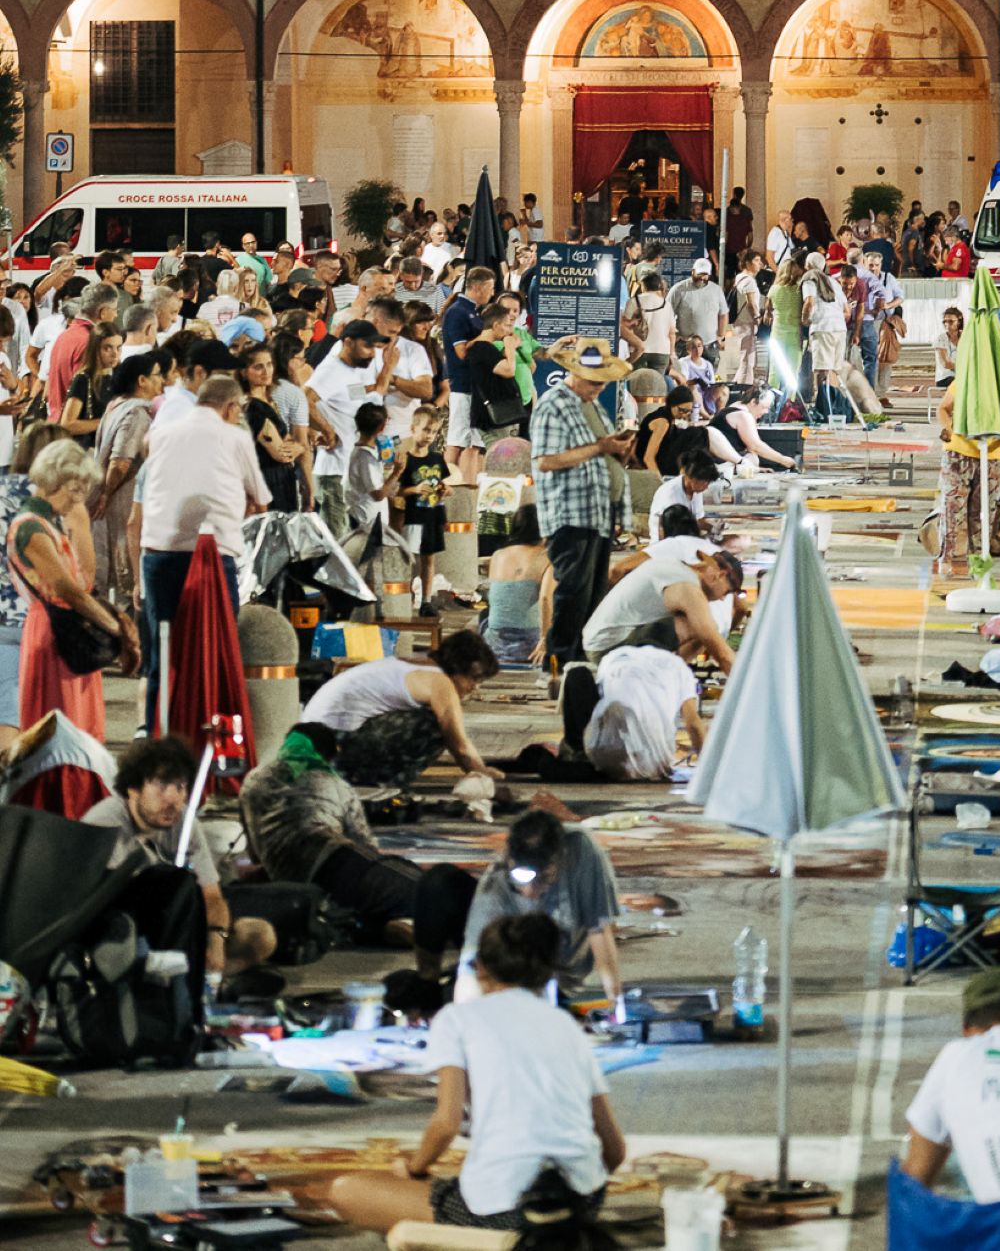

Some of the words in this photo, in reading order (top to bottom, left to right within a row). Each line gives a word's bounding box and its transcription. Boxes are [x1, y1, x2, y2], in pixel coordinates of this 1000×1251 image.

[118, 195, 155, 203] CROCE
[158, 195, 195, 203] ROSSA
[198, 194, 248, 203] ITALIANA
[541, 265, 559, 275] PER
[560, 266, 599, 277] GRAZIA
[540, 276, 590, 287] RICEVUTA
